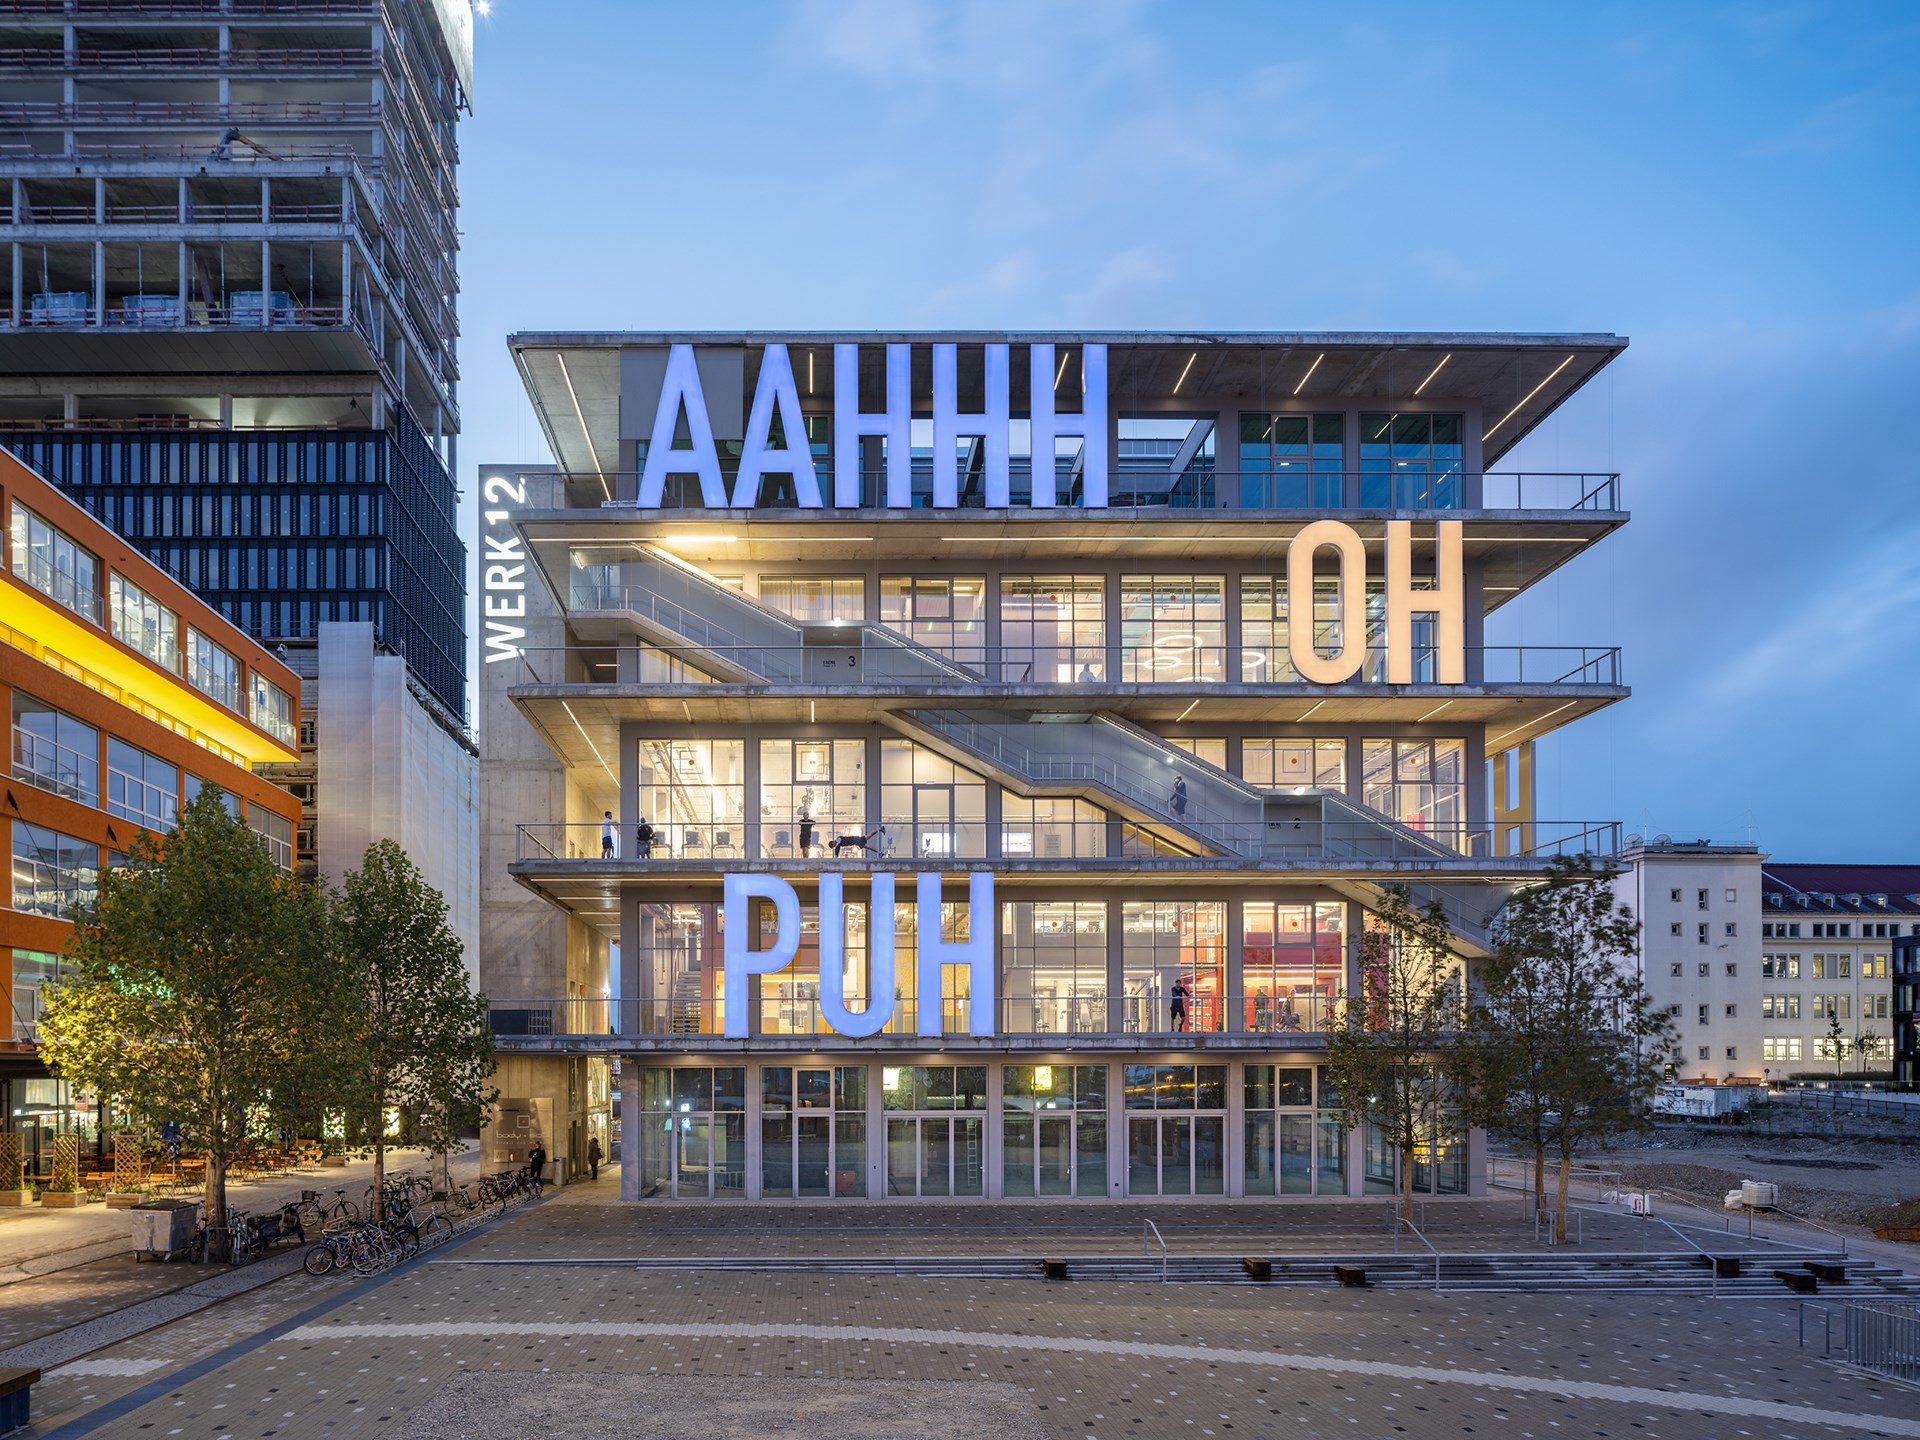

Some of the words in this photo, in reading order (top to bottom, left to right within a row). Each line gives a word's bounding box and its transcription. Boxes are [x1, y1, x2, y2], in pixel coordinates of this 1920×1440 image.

[636, 343, 1108, 509] AAHHH
[484, 477, 525, 525] 12
[485, 535, 525, 663] WERK
[1287, 519, 1464, 685] OH
[848, 655, 856, 667] 3
[1293, 817, 1301, 829] 2
[723, 872, 995, 1039] PUH
[496, 1130, 521, 1140] body
